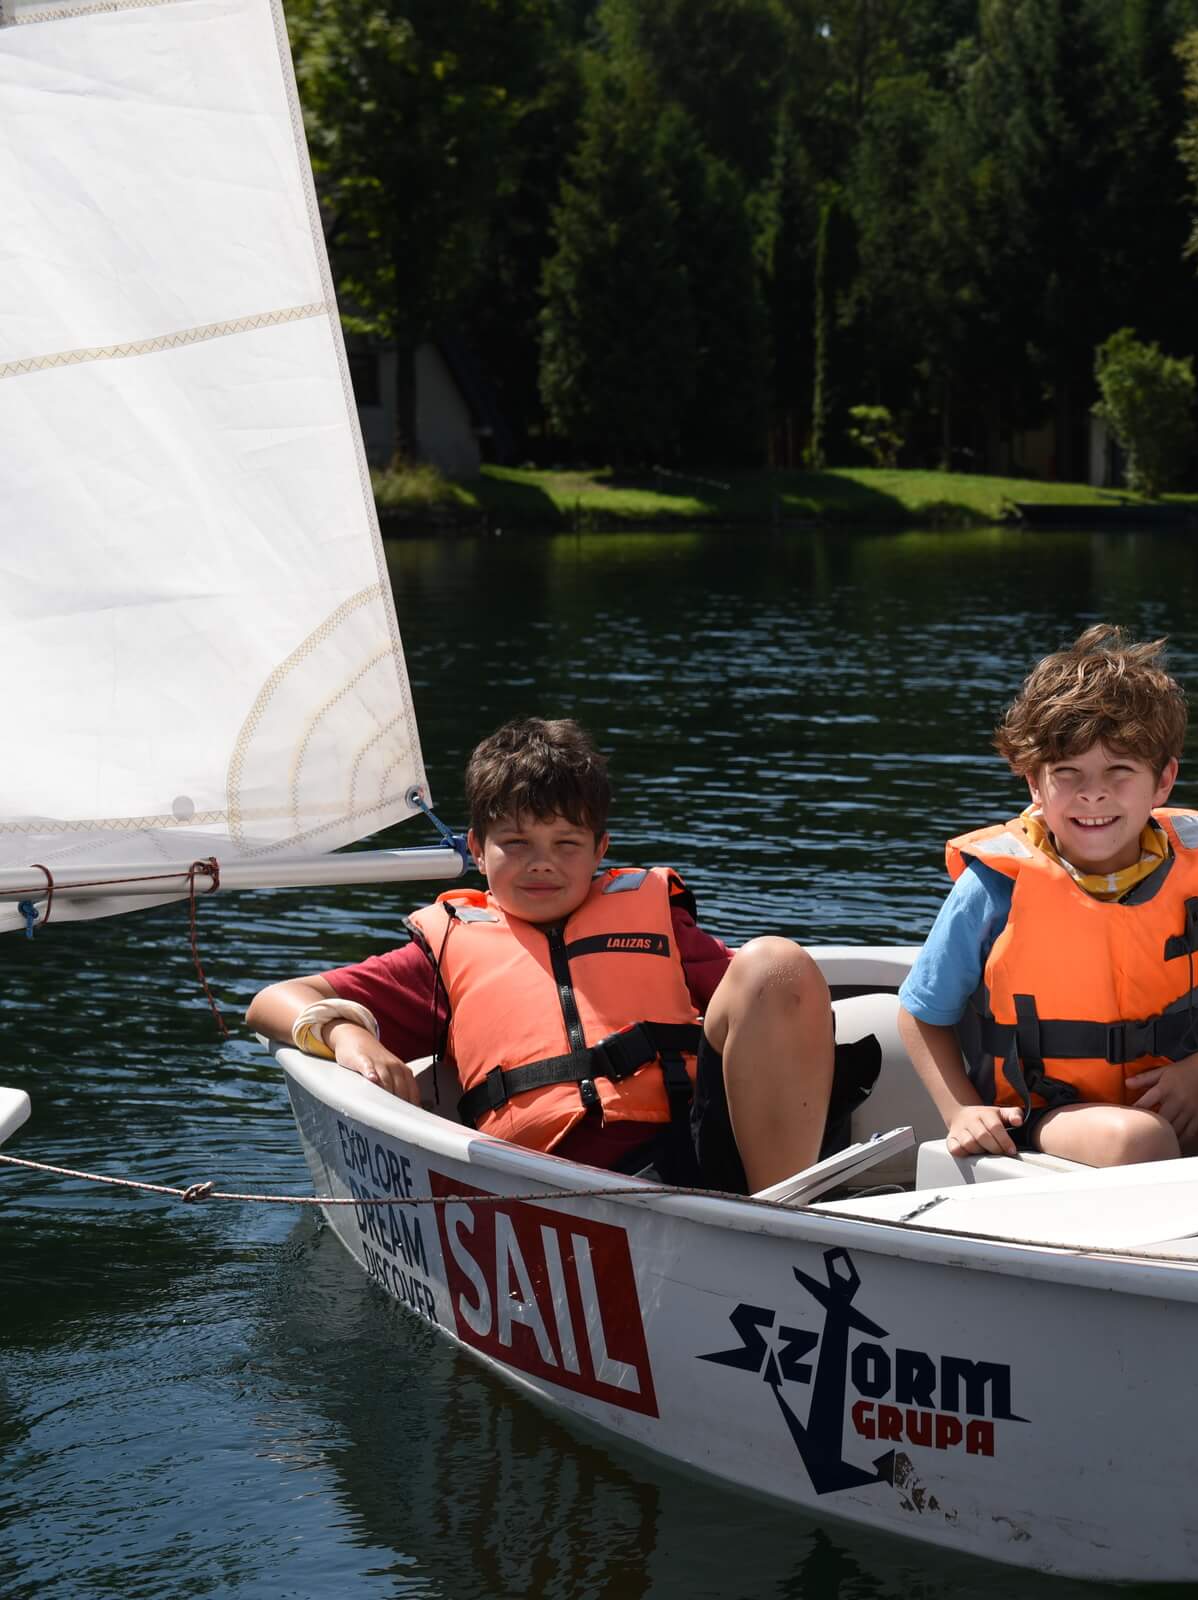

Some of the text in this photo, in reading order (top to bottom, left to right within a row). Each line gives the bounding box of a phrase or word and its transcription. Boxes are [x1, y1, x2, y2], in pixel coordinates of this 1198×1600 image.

[606, 937, 652, 949] LALIZAS
[337, 1119, 417, 1208] EXPLORE
[349, 1175, 429, 1277] DREAM
[362, 1240, 439, 1323] DISCOVER
[444, 1199, 641, 1394] SAIL
[851, 1400, 994, 1456] GRUPA
